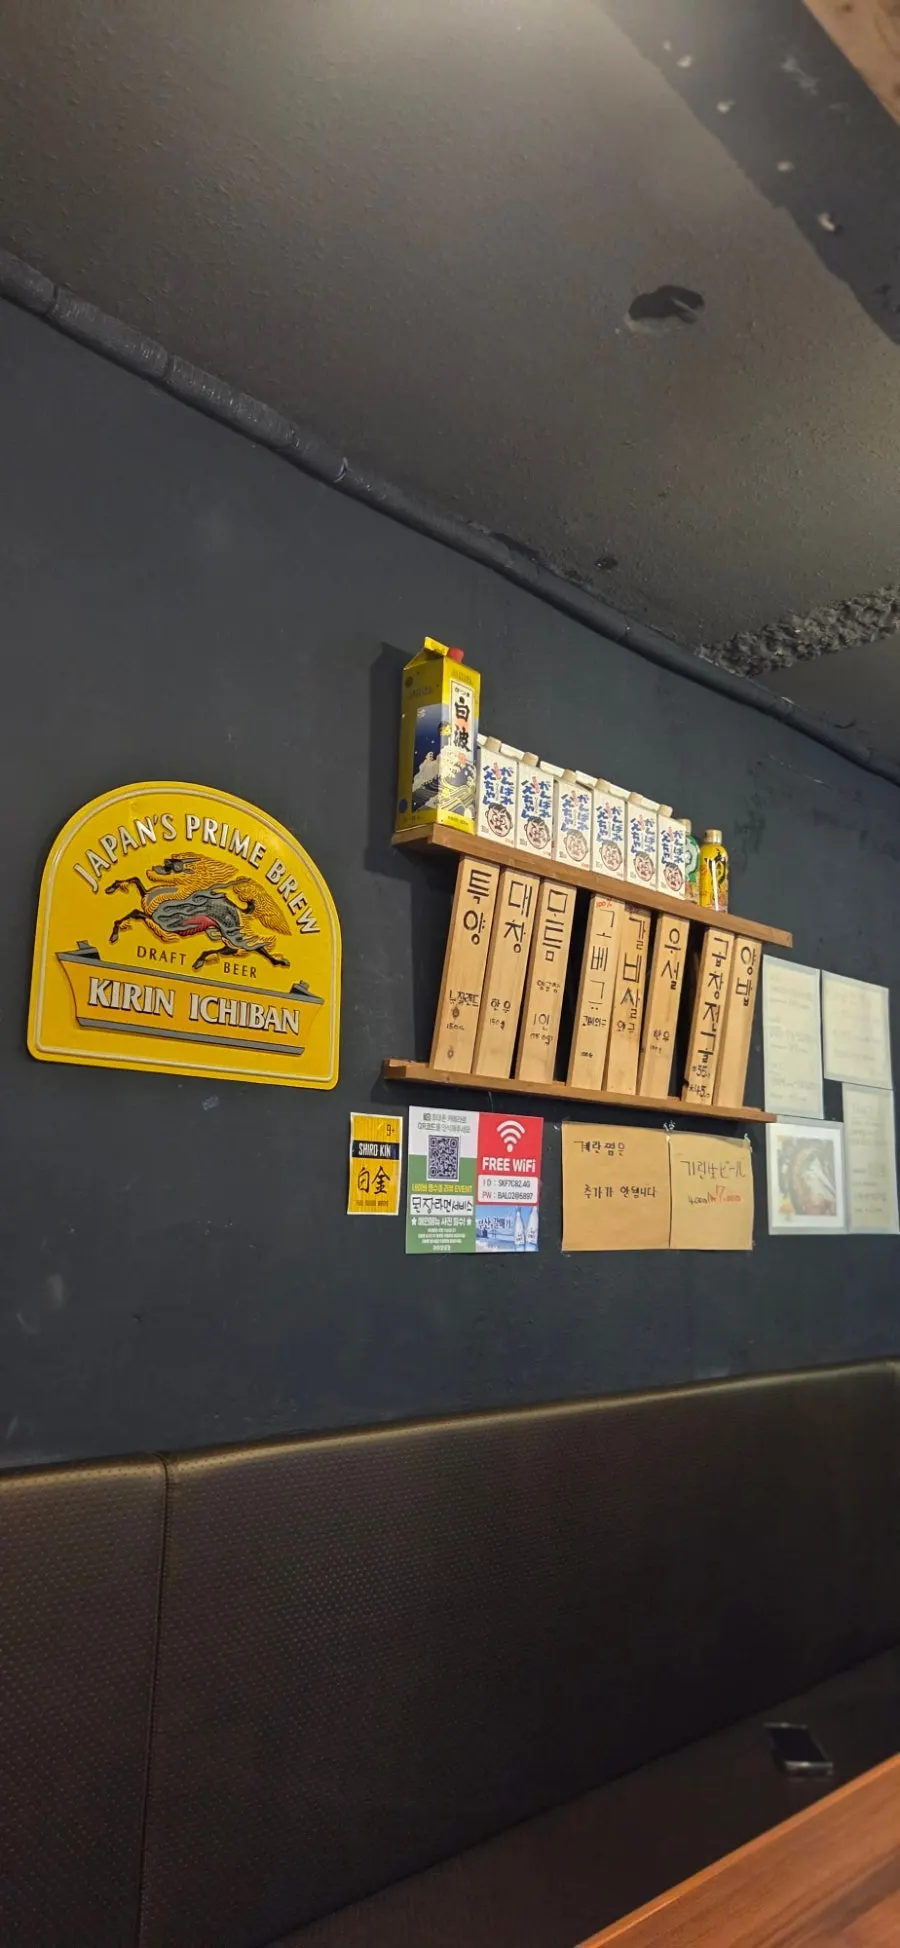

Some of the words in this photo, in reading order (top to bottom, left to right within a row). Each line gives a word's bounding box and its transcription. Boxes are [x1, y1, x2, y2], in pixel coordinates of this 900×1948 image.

[73, 813, 177, 893] JAPAN'S
[185, 813, 266, 869] PRIME
[265, 858, 321, 935] BREW
[463, 869, 492, 945] 특양
[503, 880, 533, 953] 대창
[542, 889, 568, 962] 모듬
[136, 945, 187, 966] DRAFT
[223, 961, 258, 979] BEER
[620, 916, 646, 1020] 갈비살
[661, 927, 682, 990] 우설
[735, 946, 757, 1006] 양밥
[87, 976, 176, 1018] KIRIN
[188, 993, 301, 1036] ICHIBAN
[358, 1143, 379, 1157] SHIRO
[380, 1144, 392, 1158] KIN
[482, 1157, 510, 1171] FREE
[512, 1158, 536, 1173] WiFi
[482, 1191, 492, 1199] PW
